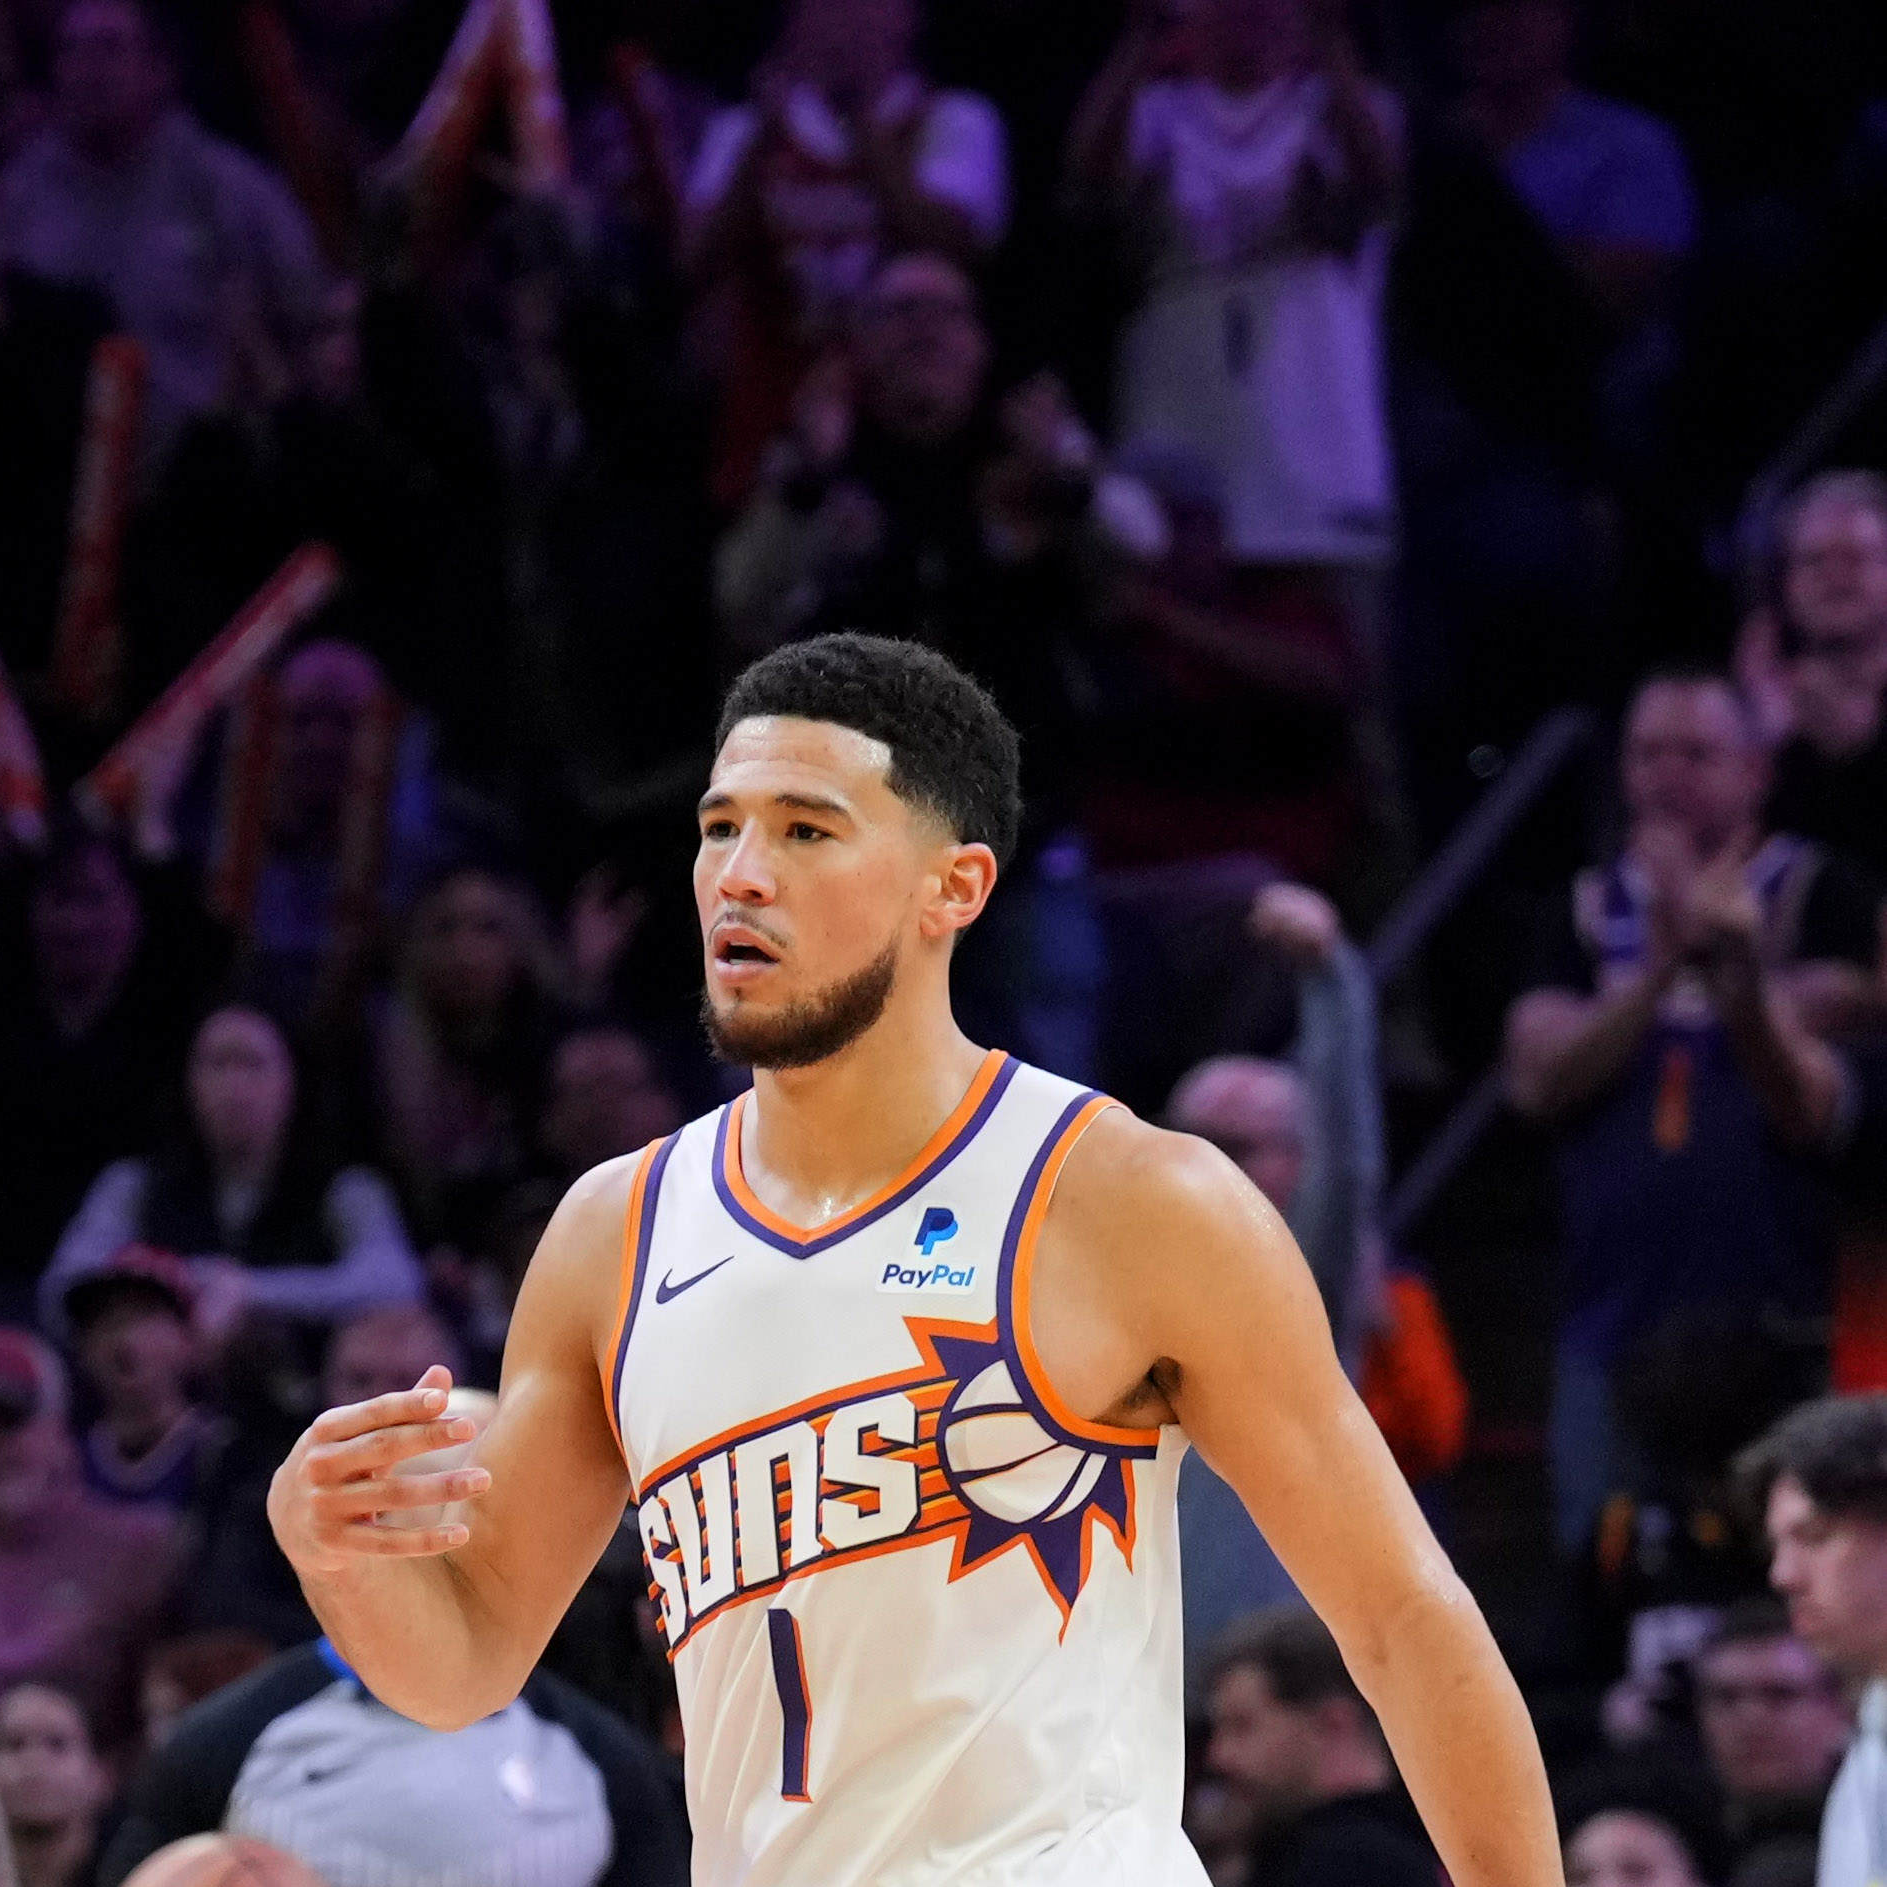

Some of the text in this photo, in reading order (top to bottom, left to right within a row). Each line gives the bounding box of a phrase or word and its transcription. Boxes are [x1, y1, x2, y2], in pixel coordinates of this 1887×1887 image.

[882, 1263, 975, 1288] PayPal
[638, 1392, 921, 1648] SUNS
[767, 1608, 813, 1804] 1
